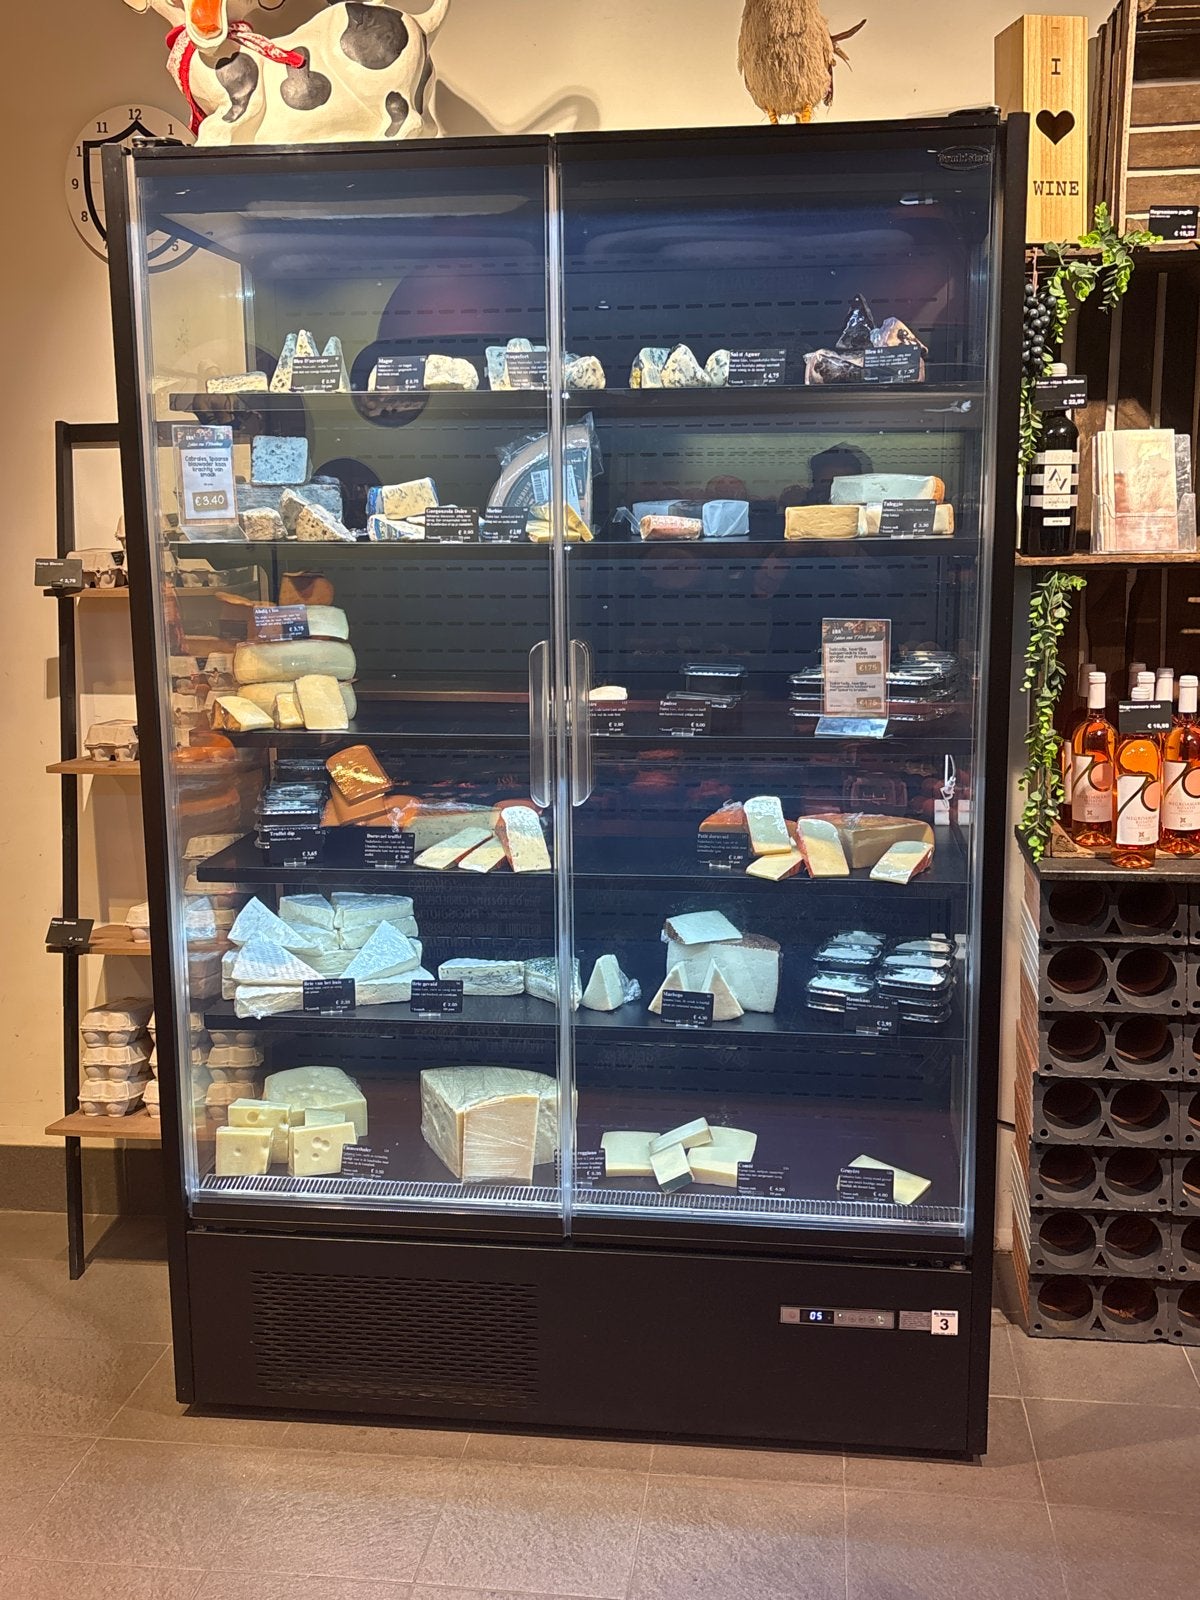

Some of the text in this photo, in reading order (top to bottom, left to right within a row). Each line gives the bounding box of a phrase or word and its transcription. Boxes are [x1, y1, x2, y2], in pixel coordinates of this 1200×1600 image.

[1051, 58, 1061, 75] I
[128, 108, 142, 120] 12
[96, 121, 109, 133] 11
[168, 123, 174, 135] 1
[71, 177, 79, 190] 9
[1033, 180, 1079, 196] WINE
[80, 210, 88, 223] 8
[195, 494, 225, 506] €3.40
[808, 1311, 823, 1321] 05
[939, 1317, 949, 1331] 3
